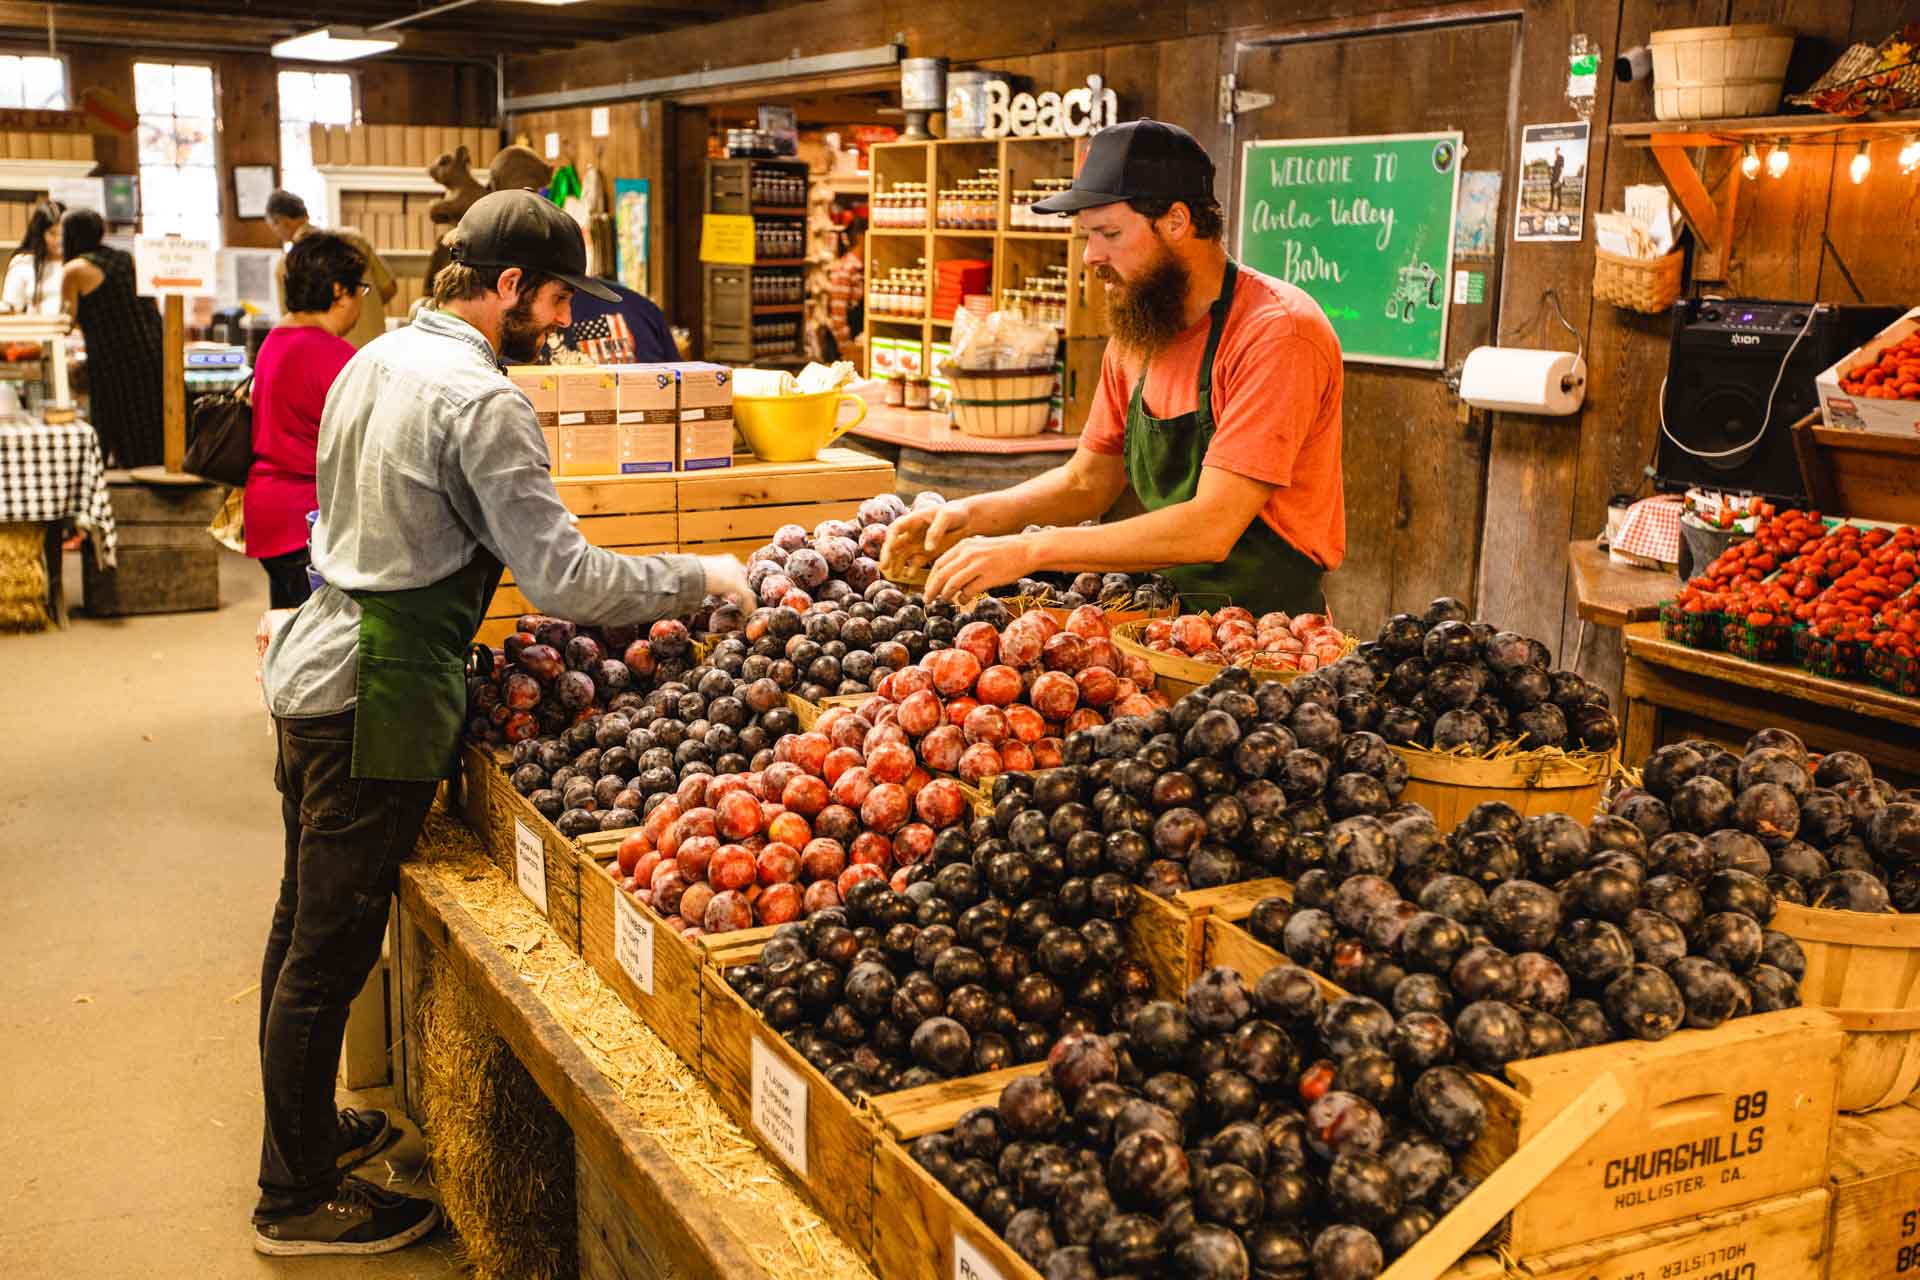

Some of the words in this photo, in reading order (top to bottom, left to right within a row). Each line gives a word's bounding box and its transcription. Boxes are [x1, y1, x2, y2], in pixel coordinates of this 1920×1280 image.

[982, 74, 1118, 137] Beach
[1270, 156, 1353, 188] WELCOME
[1373, 152, 1398, 183] TO
[1328, 196, 1398, 251] Valley
[1282, 239, 1349, 284] Barn
[1733, 1090, 1768, 1123] 89
